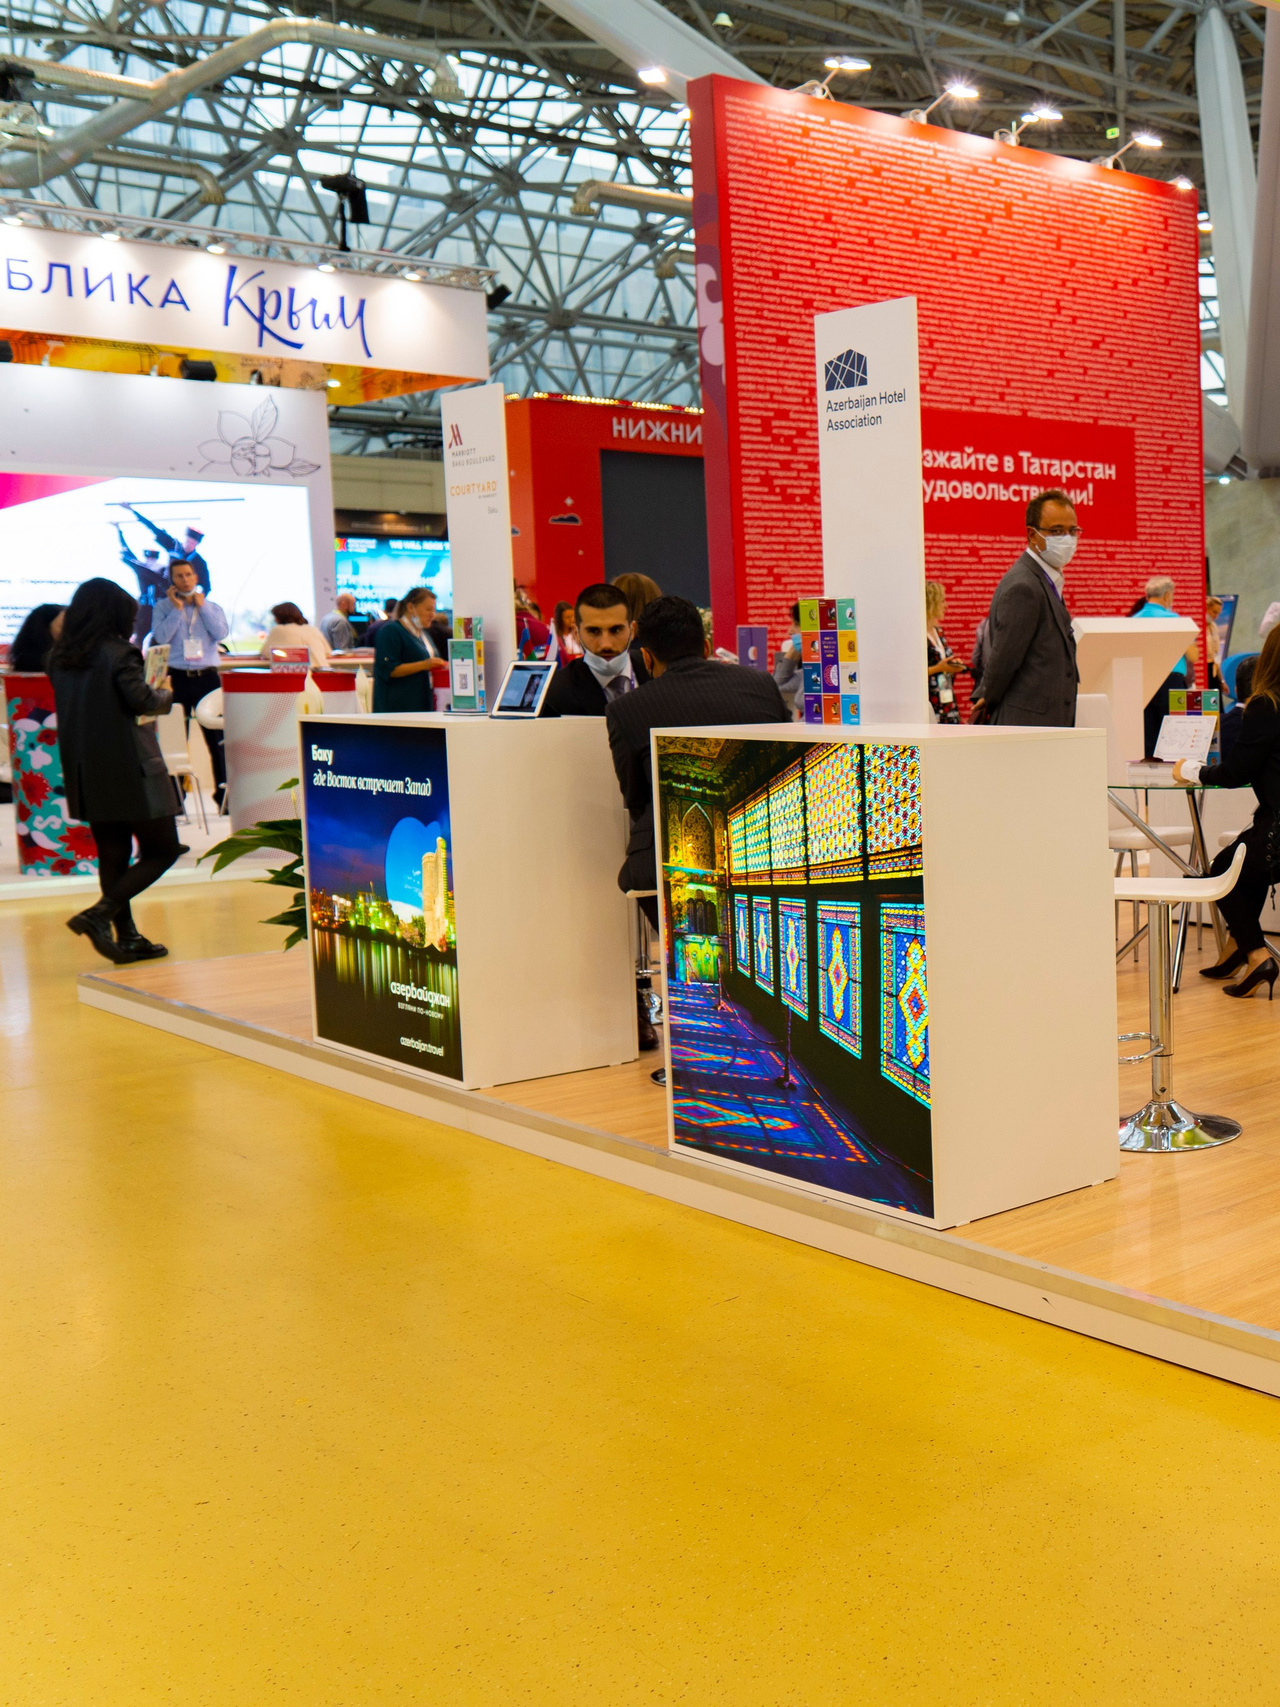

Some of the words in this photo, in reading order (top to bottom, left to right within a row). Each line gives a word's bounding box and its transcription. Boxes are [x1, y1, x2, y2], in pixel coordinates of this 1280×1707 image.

[6, 258, 191, 312] БЛИКА
[222, 264, 373, 358] Крым
[826, 395, 877, 413] Azerbaijan
[879, 388, 906, 405] Hotel
[826, 413, 882, 432] Association
[451, 448, 476, 458] MARRIOTT
[466, 455, 496, 466] BOULEVARD
[1003, 455, 1015, 473] в
[1018, 451, 1116, 484] Татарстан
[450, 480, 498, 497] COURTYARD
[311, 744, 333, 766] Баку
[313, 768, 326, 787] где
[326, 770, 357, 789] Восток
[357, 776, 404, 796] встречает
[404, 776, 432, 797] Запад
[390, 981, 451, 1008] азербайджан
